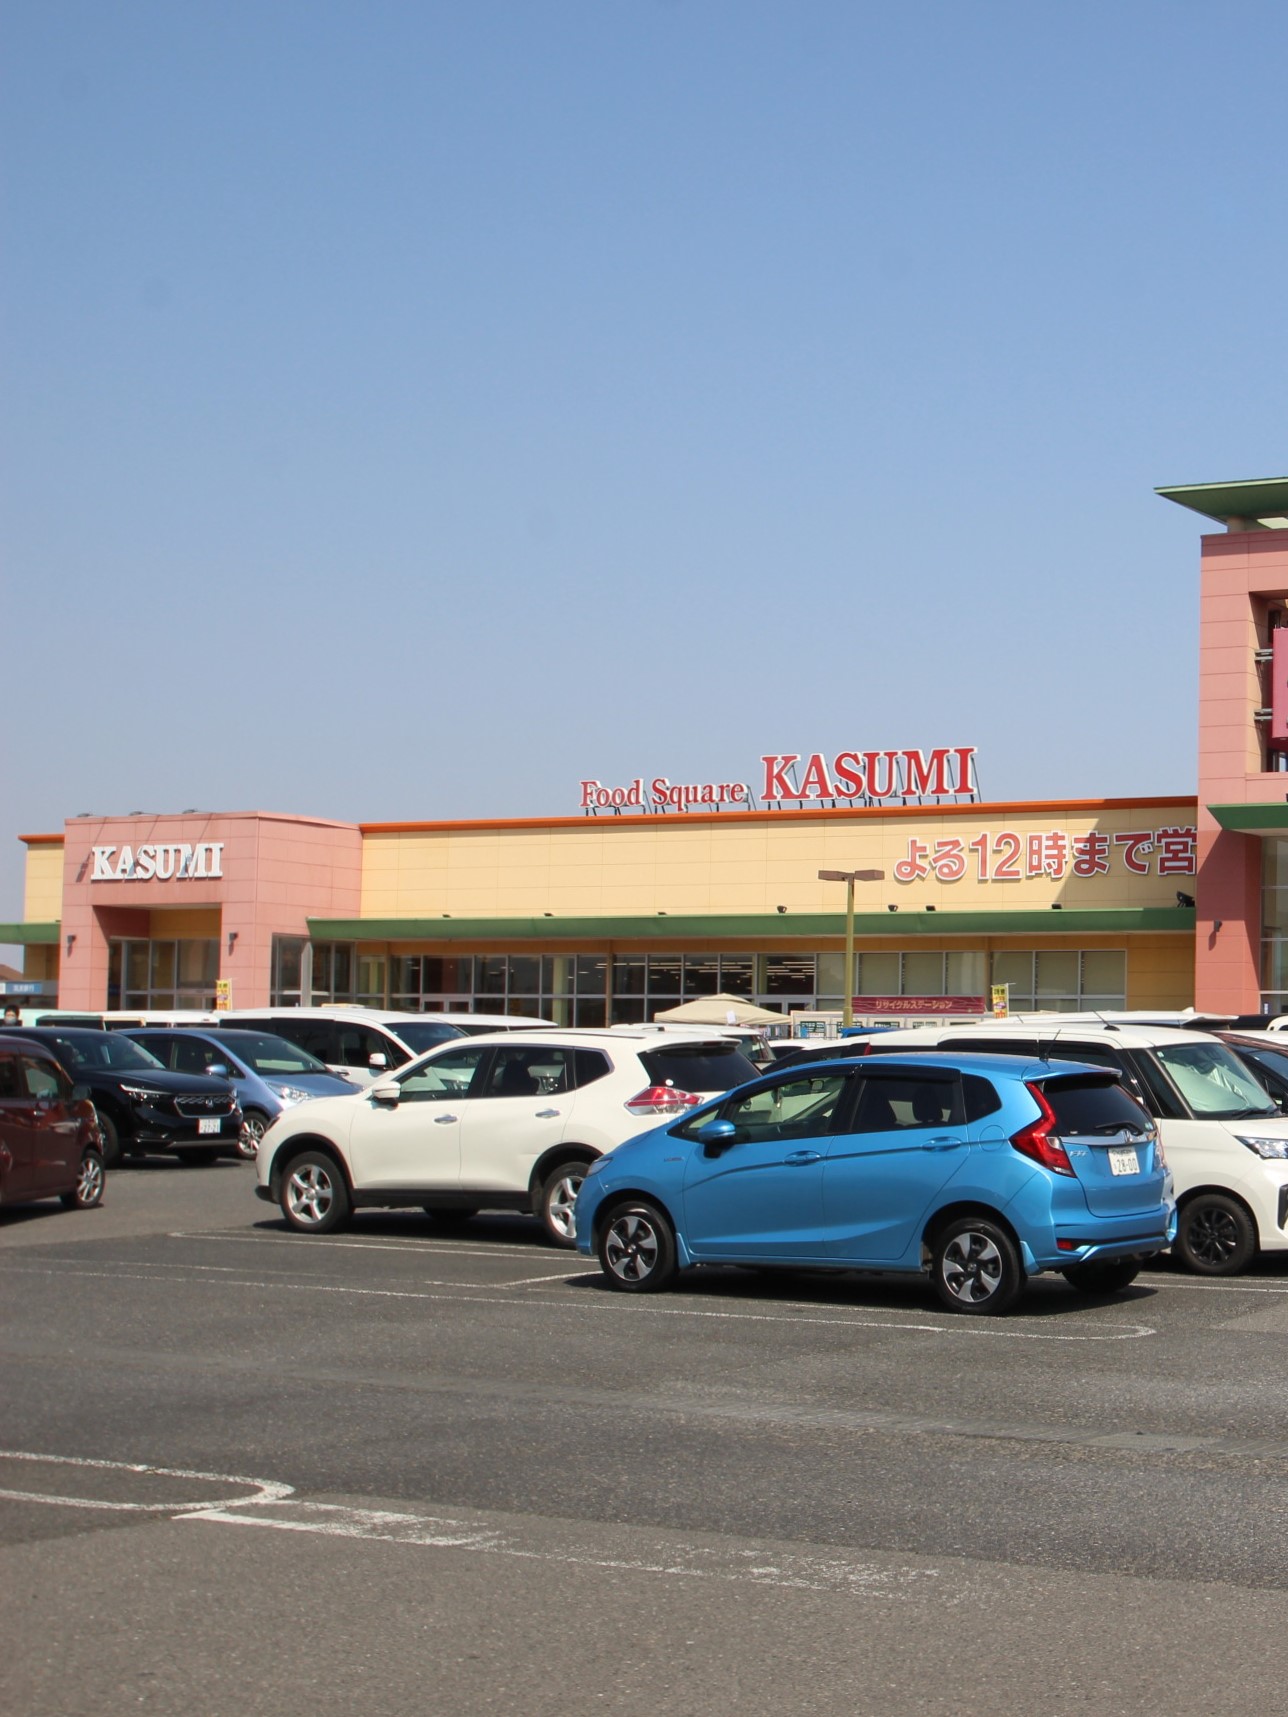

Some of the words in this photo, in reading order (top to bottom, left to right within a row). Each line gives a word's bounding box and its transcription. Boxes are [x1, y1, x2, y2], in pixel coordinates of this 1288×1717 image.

[579, 779, 645, 807] Food
[651, 777, 747, 812] Square
[760, 746, 978, 801] KASUMI
[91, 843, 224, 880] KASUMI
[894, 826, 1198, 880] よる12時まで営
[875, 1000, 953, 1010] リサイクルステーション
